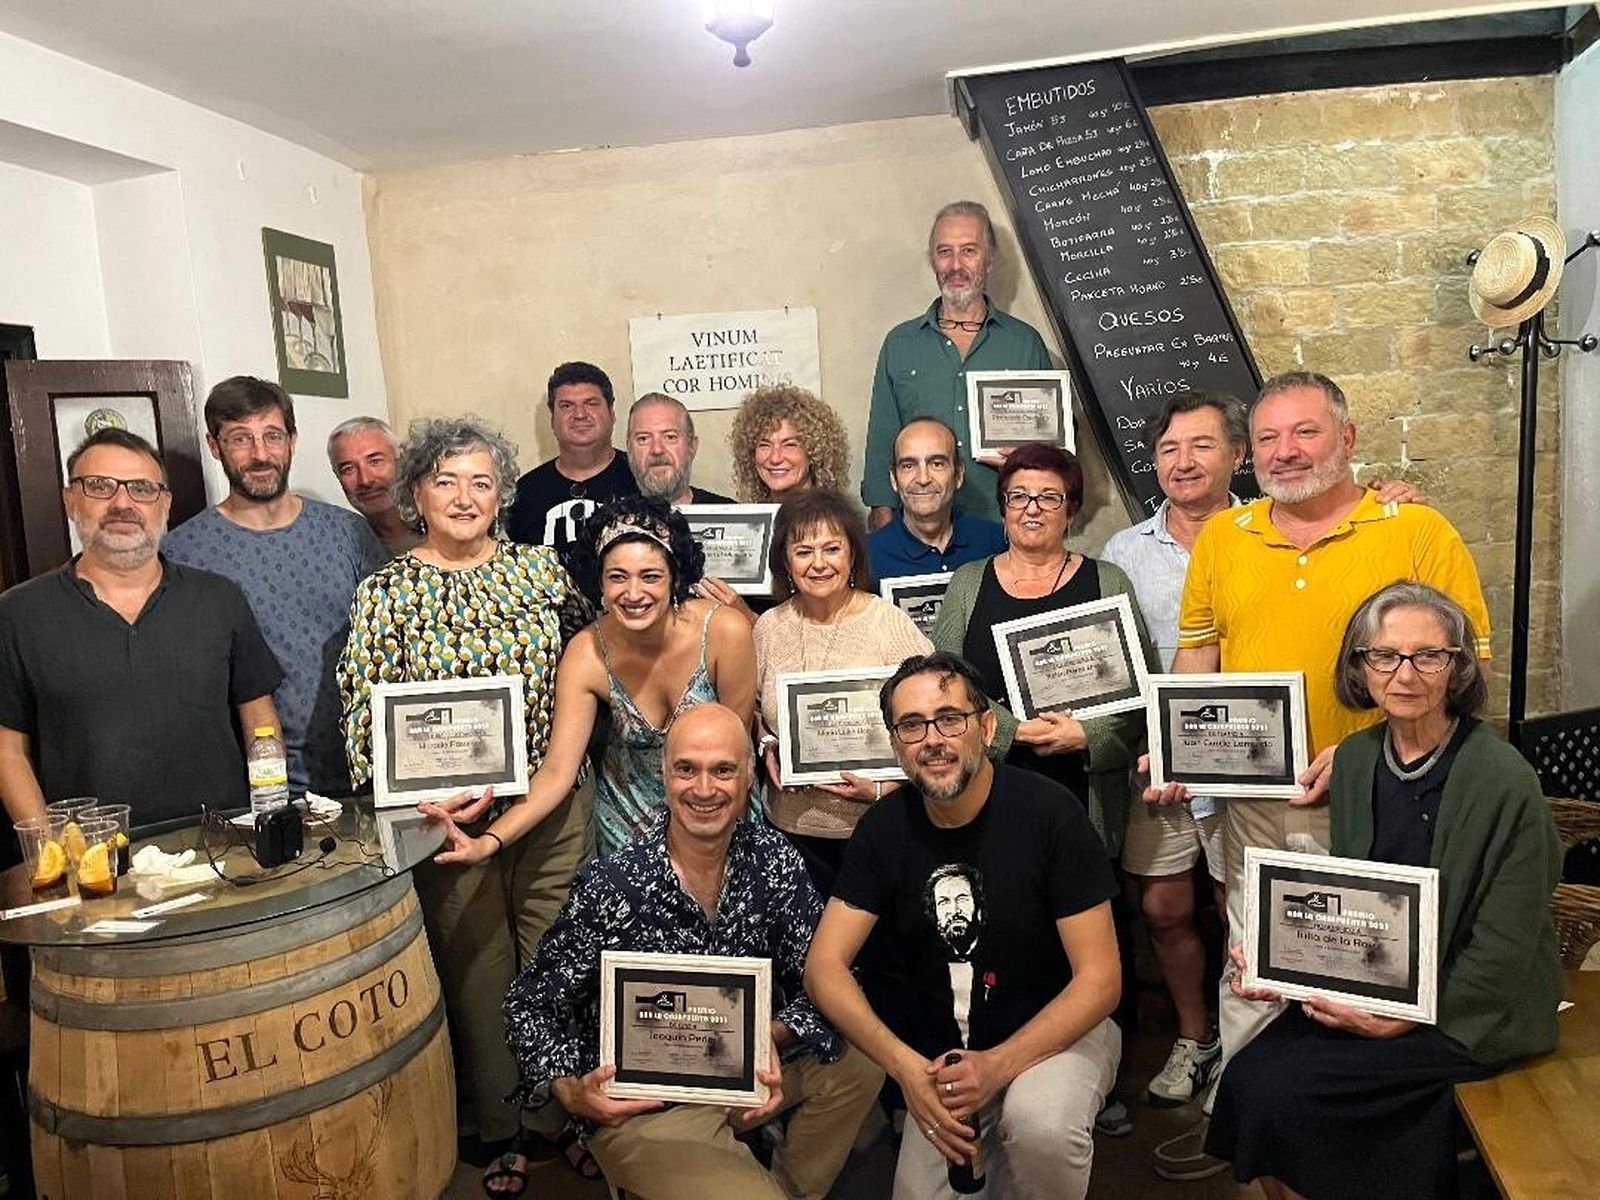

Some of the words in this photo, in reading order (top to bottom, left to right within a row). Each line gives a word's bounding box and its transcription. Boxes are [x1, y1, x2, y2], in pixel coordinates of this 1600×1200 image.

[1005, 79, 1096, 116] EMBUTIDOS
[1021, 164, 1051, 178] LOMO
[1029, 168, 1113, 197] CHICHARRONES
[1035, 197, 1074, 213] CARNE
[1050, 227, 1115, 248] BOTIFARRA
[1060, 244, 1114, 261] MORCILLA
[1064, 267, 1111, 284] CECINA
[1070, 286, 1126, 301] PANCETA
[1129, 281, 1166, 294] HORNO
[1098, 307, 1185, 331] QUESOS
[691, 328, 759, 348] VINUM
[1094, 343, 1165, 359] PREGUNTAR
[1194, 332, 1234, 346] BARRA
[669, 350, 783, 371] LAETIFICAT
[663, 377, 702, 394] COR
[1119, 375, 1191, 401] VARIOS
[1342, 908, 1376, 920] PREMIO
[1296, 929, 1320, 941] Julia
[1324, 933, 1337, 943] de
[1340, 936, 1351, 946] la
[195, 1032, 278, 1084] EL
[294, 969, 409, 1053] COTO
